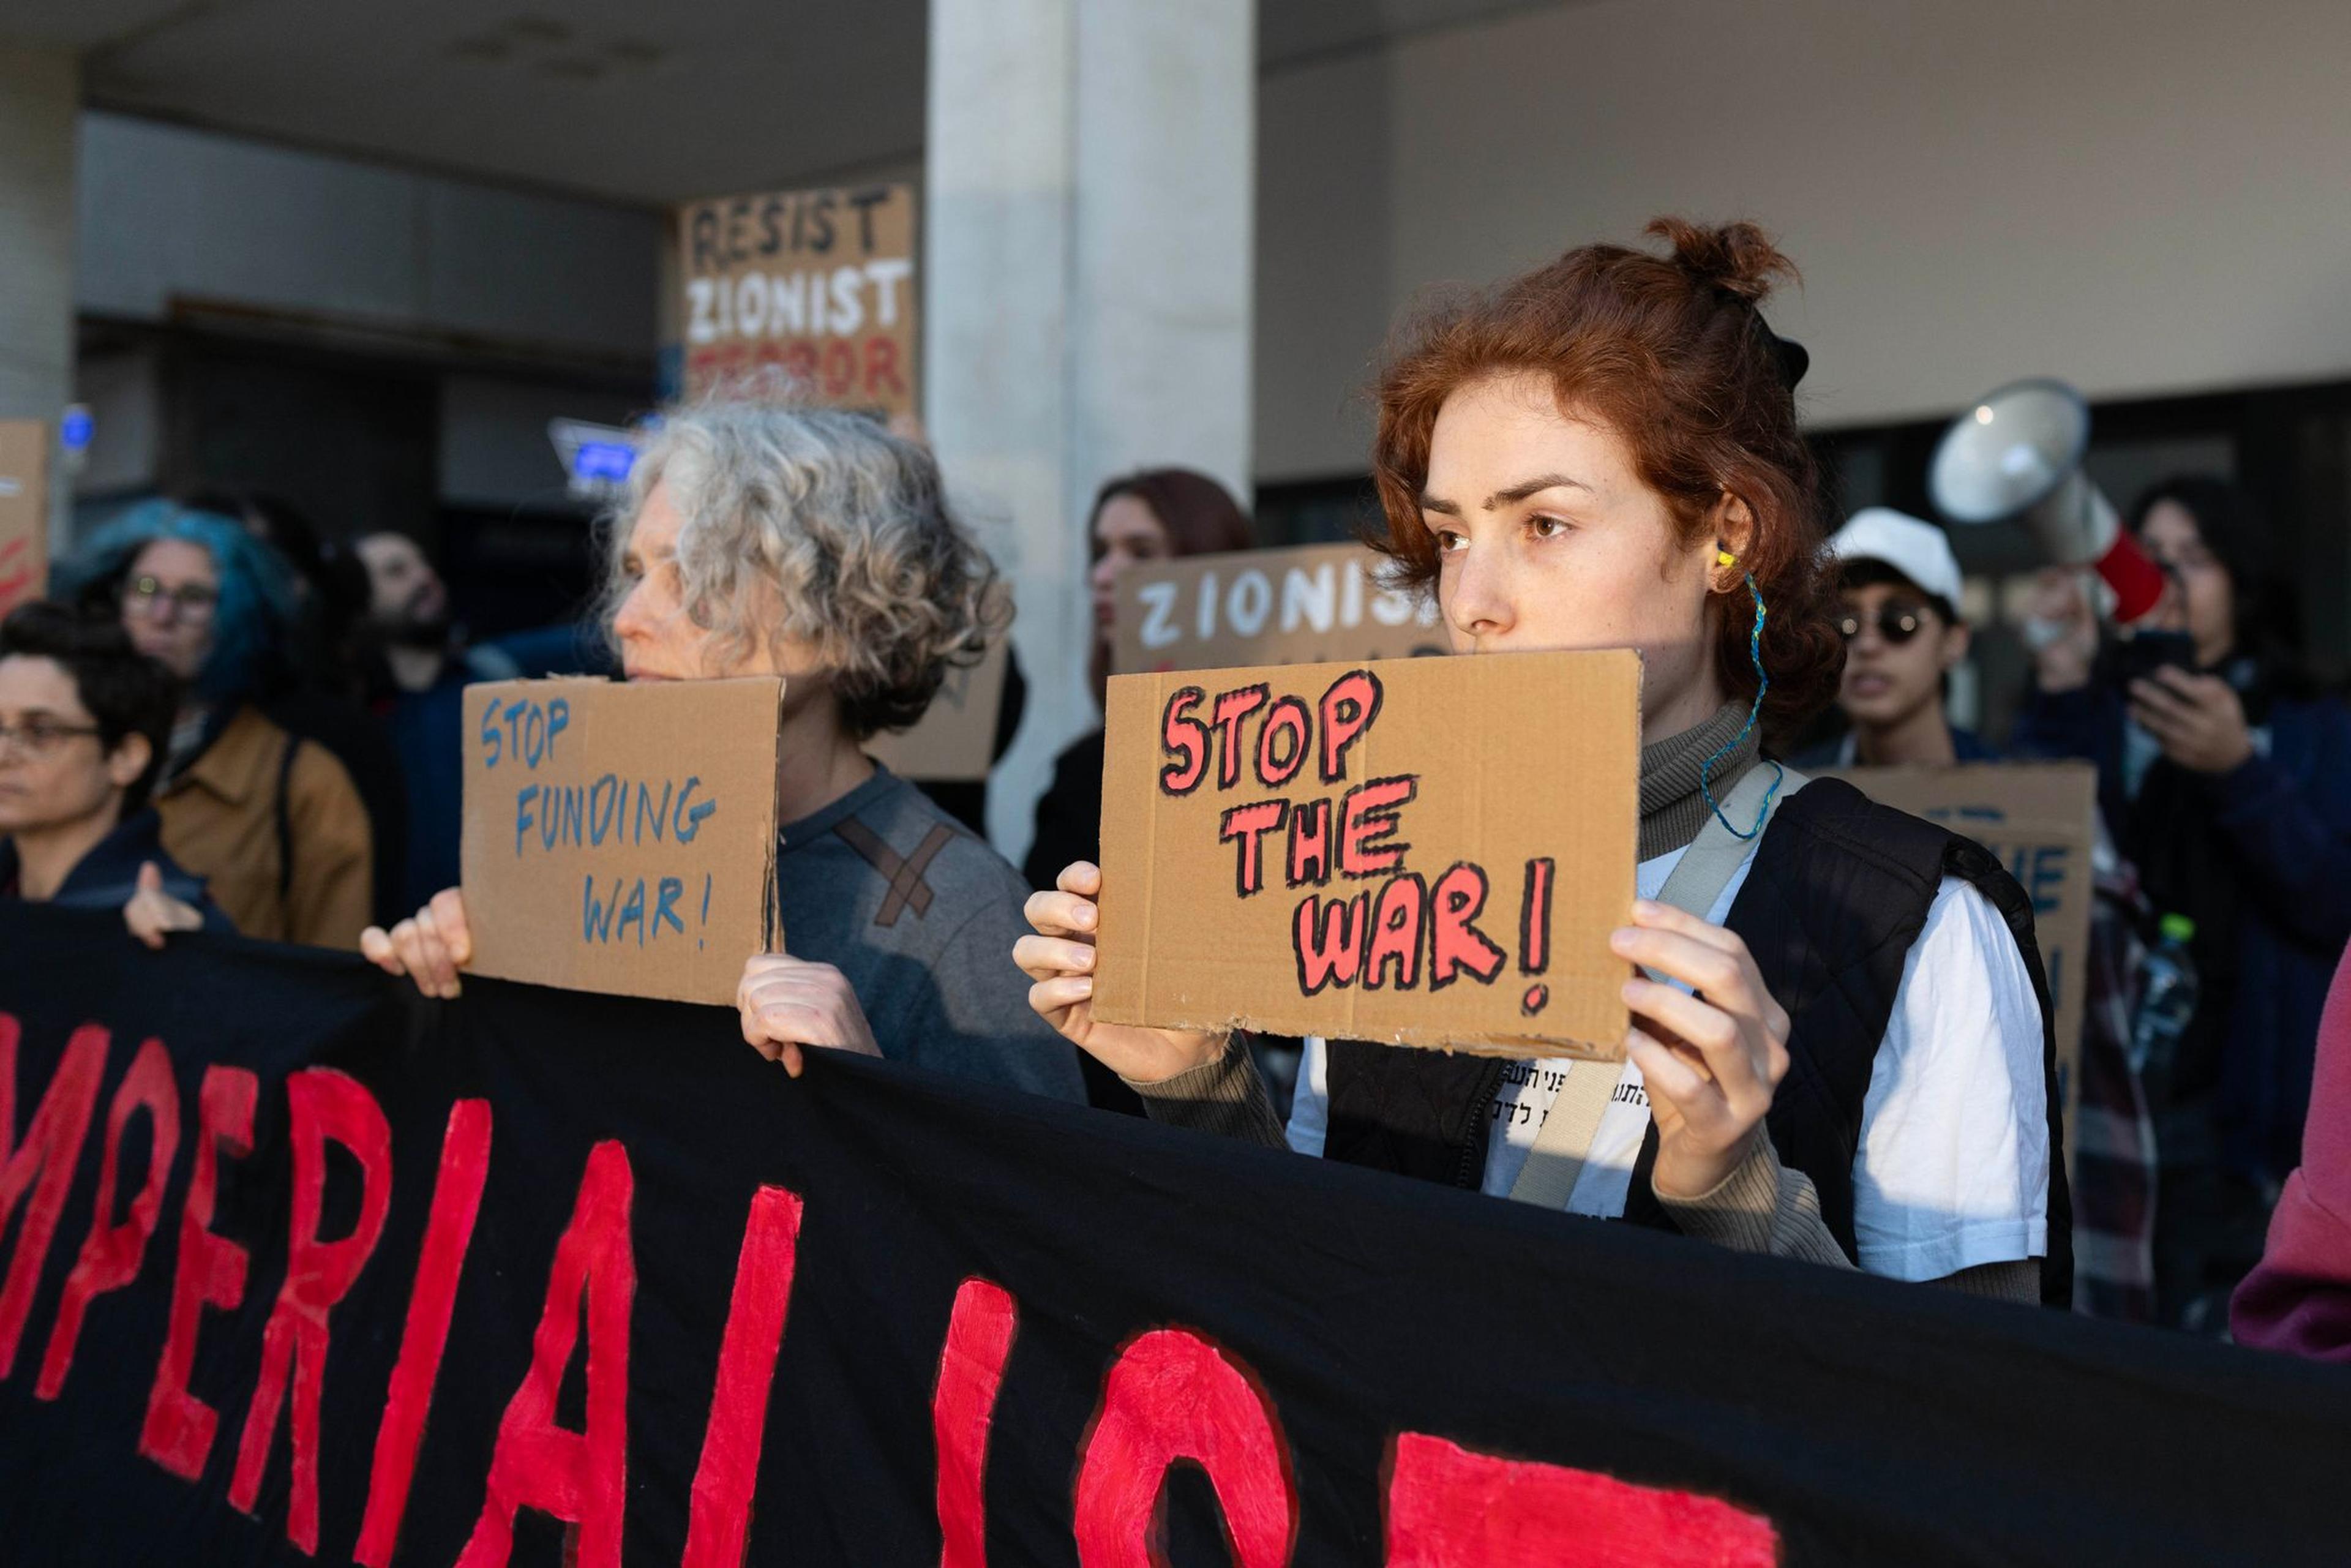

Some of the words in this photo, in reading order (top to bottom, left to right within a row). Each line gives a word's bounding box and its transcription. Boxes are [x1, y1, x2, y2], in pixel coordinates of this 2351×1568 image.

[692, 186, 890, 272] RESIST
[686, 258, 911, 343] ZIONIST
[481, 698, 569, 769] STOP
[1159, 670, 1384, 796] STOP
[516, 774, 716, 858] FUNDING
[1219, 774, 1422, 898] THE
[583, 872, 712, 953] WAR!
[1291, 857, 1555, 1016] WAR!
